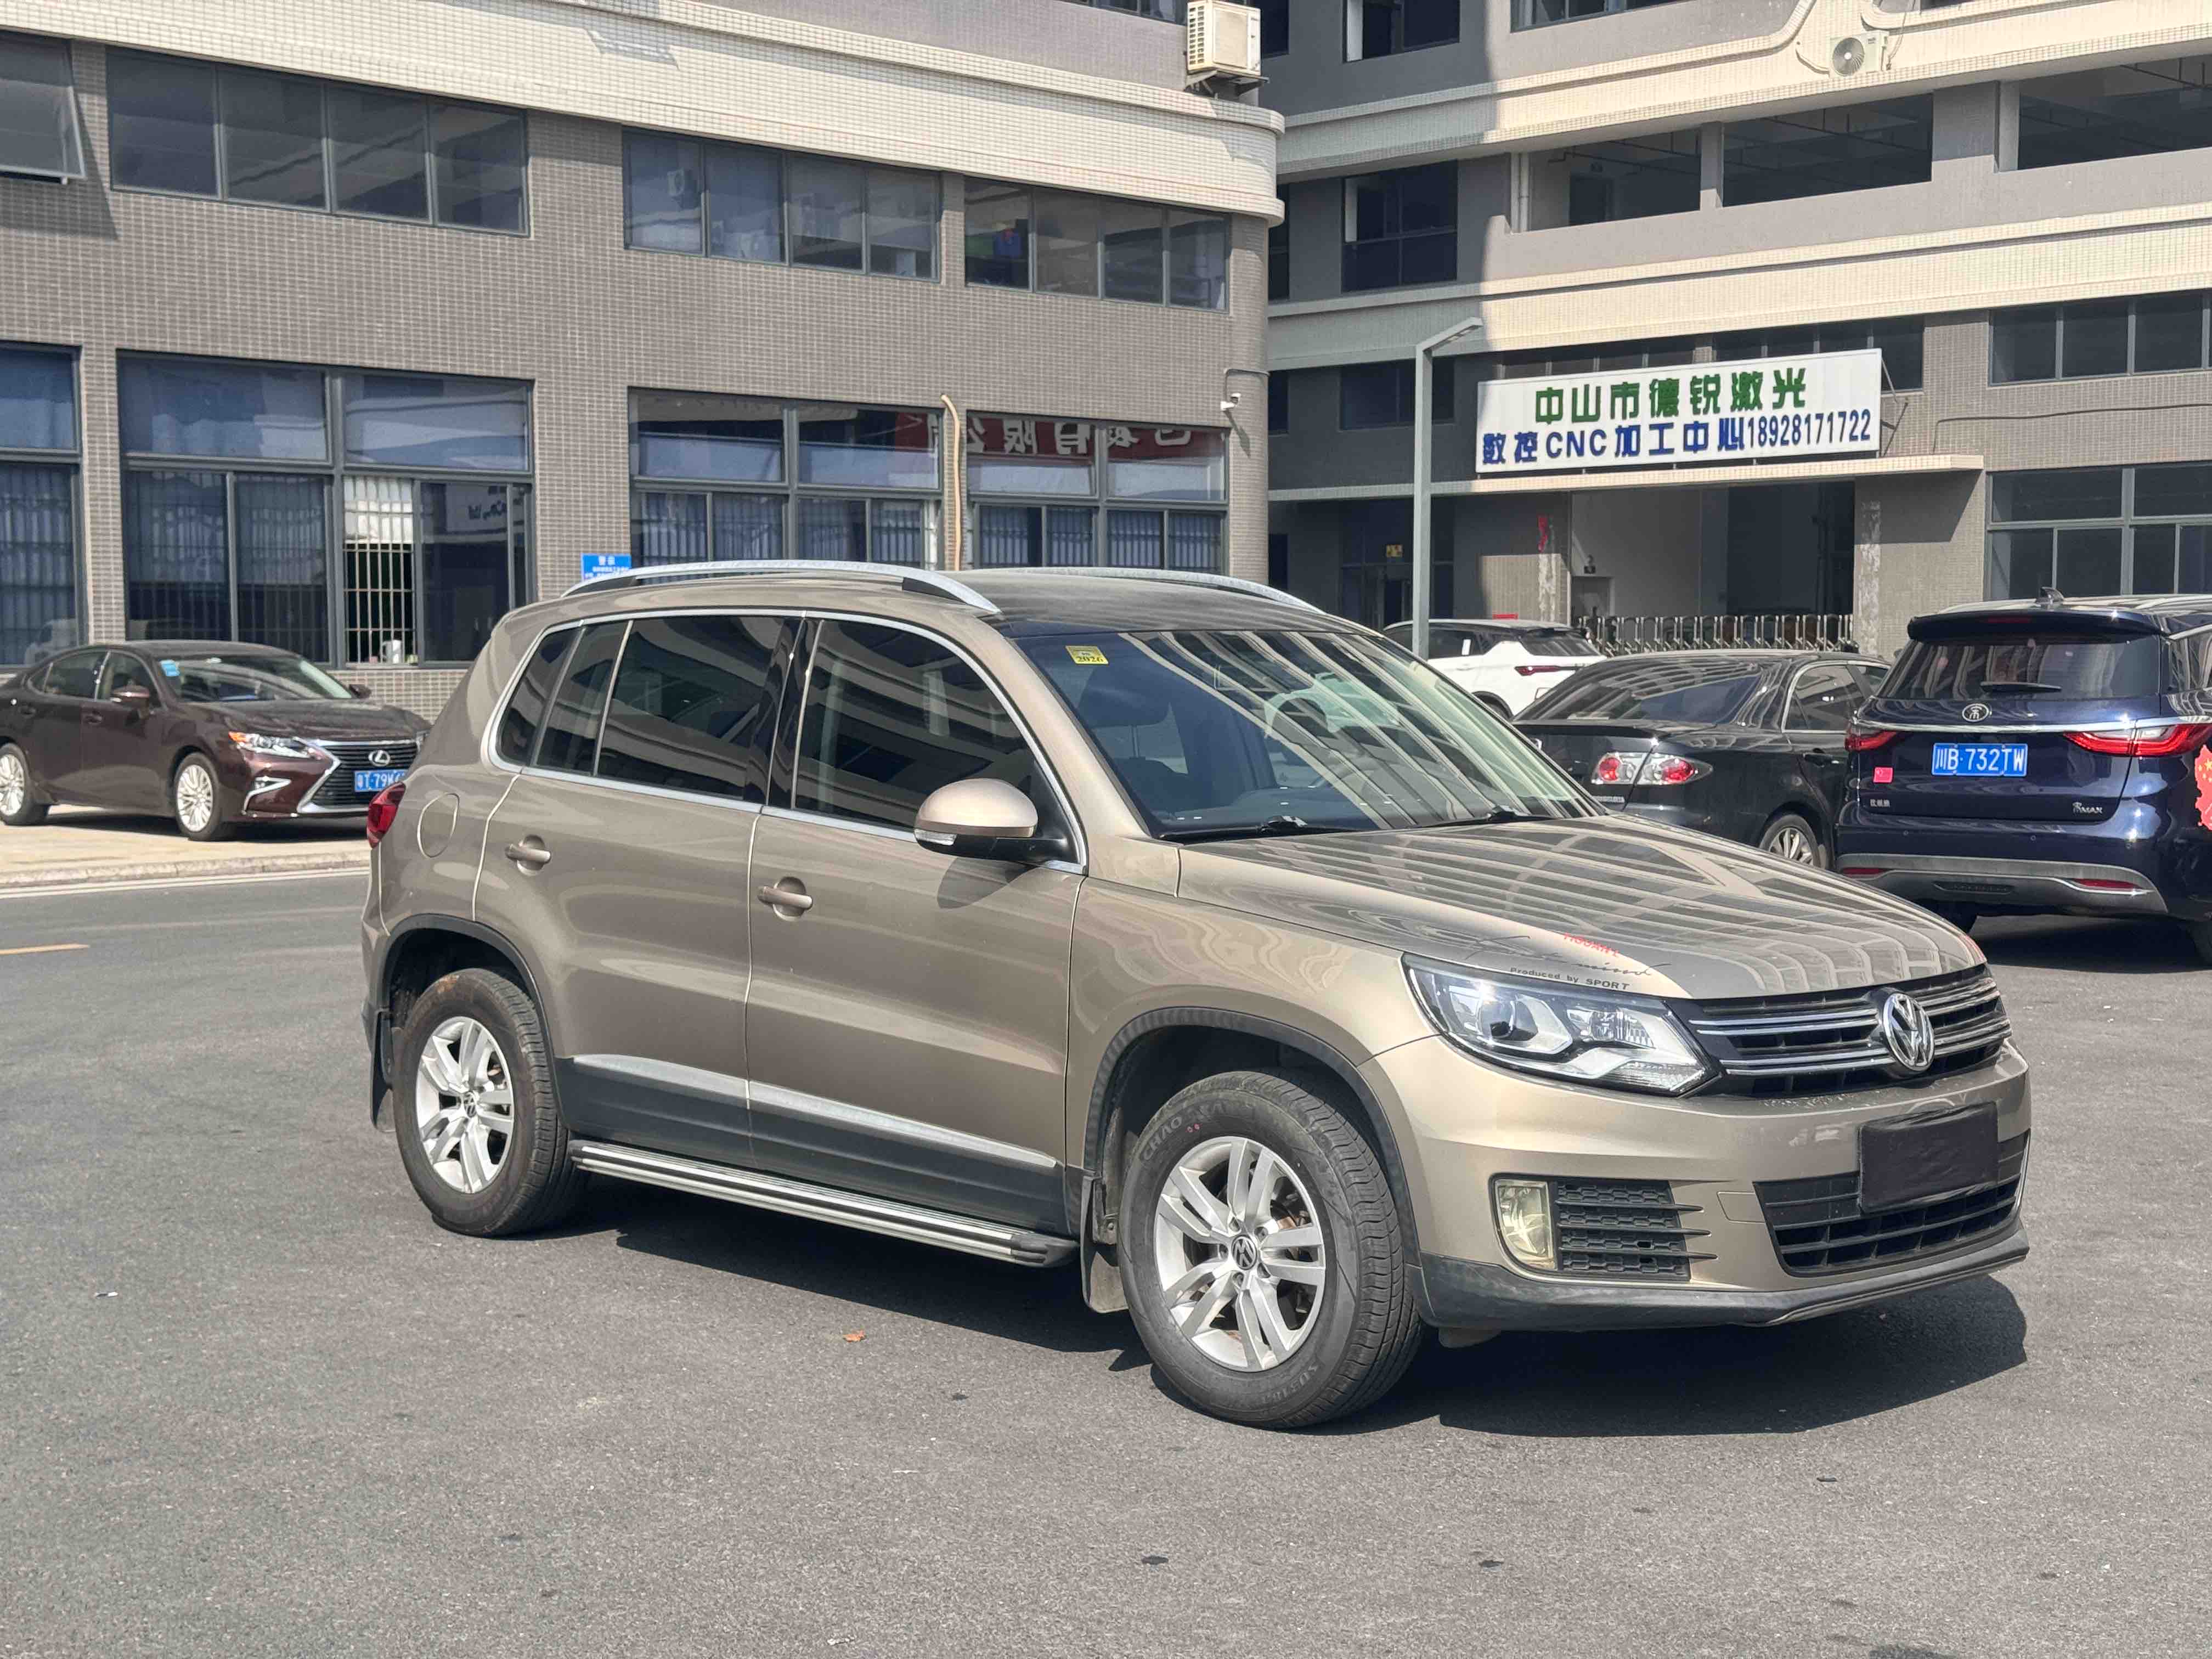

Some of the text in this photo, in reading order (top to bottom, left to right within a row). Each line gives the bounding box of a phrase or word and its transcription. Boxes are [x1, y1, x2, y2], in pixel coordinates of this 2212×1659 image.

[1934, 748, 2025, 772] 川B·732TW
[1510, 967, 1629, 990] Produced by SPORT
